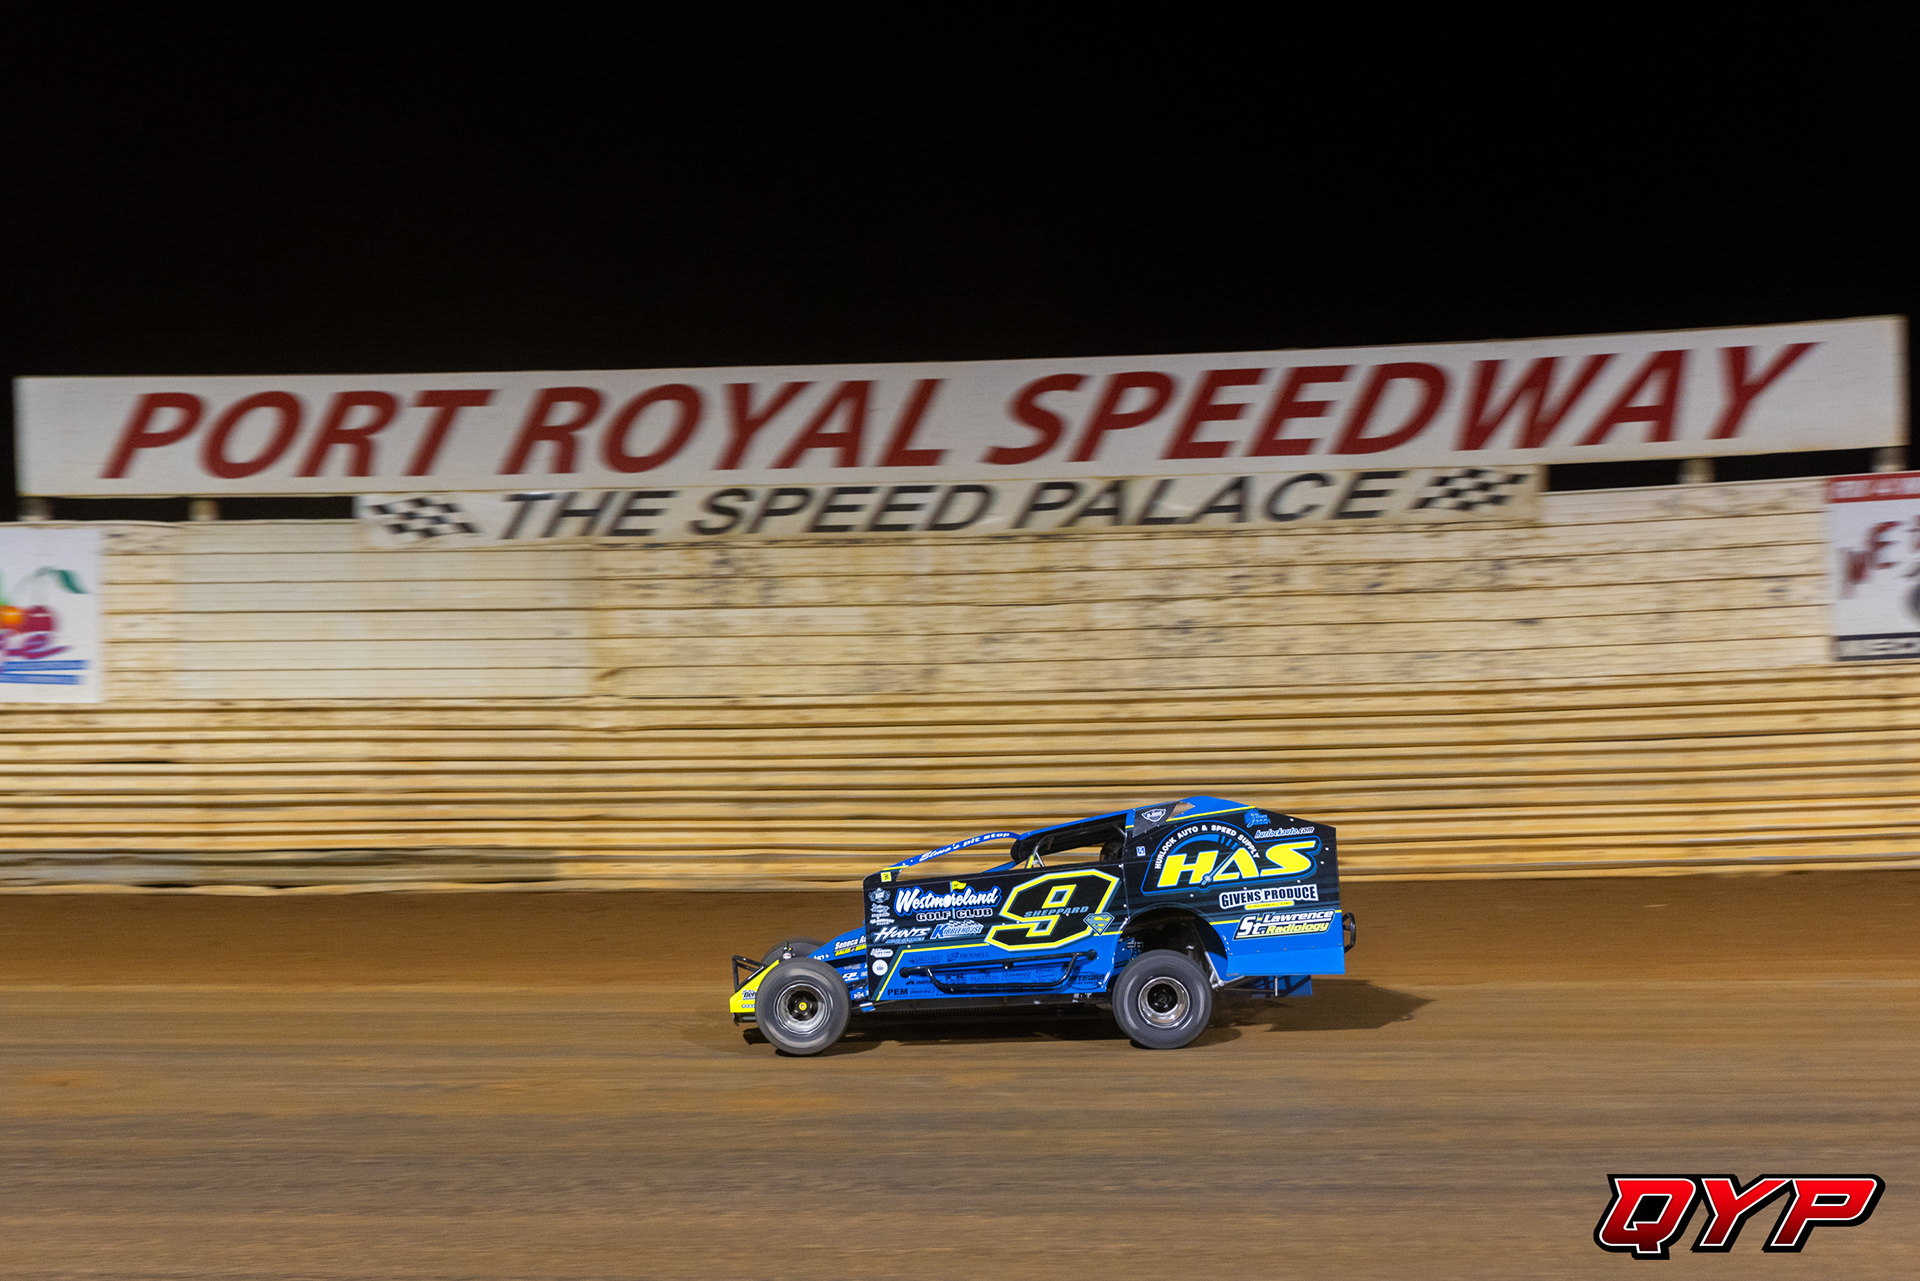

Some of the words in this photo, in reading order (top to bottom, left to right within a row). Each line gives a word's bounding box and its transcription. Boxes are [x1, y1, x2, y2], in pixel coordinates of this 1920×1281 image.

[99, 389, 498, 479] PORT
[500, 379, 948, 475] ROYAL
[980, 342, 1824, 466] SPEEDWAY
[502, 490, 676, 540] THE
[689, 483, 995, 537] SPEED
[1011, 469, 1406, 529] PALACE
[963, 836, 981, 847] pit
[983, 831, 1010, 841] stop
[1254, 826, 1315, 839] hurlockauto.com
[1155, 837, 1177, 869] HURLOCK
[1177, 825, 1199, 839] AUTO
[1211, 824, 1237, 837] SPEED
[1238, 834, 1261, 859] SUPPLY
[1157, 840, 1317, 888] HAS
[895, 887, 999, 913] Westmoreland
[1221, 891, 1261, 908] GIVENS
[1264, 886, 1317, 900] PRODUCE
[916, 911, 951, 922] GOLF
[956, 908, 993, 919] CLUB
[983, 869, 1120, 952] 9
[1024, 906, 1089, 917] SHEPPARD
[1236, 916, 1266, 936] St.
[1263, 910, 1334, 923] Lawrence
[1266, 922, 1330, 935] Radiology
[834, 938, 858, 950] Seneca
